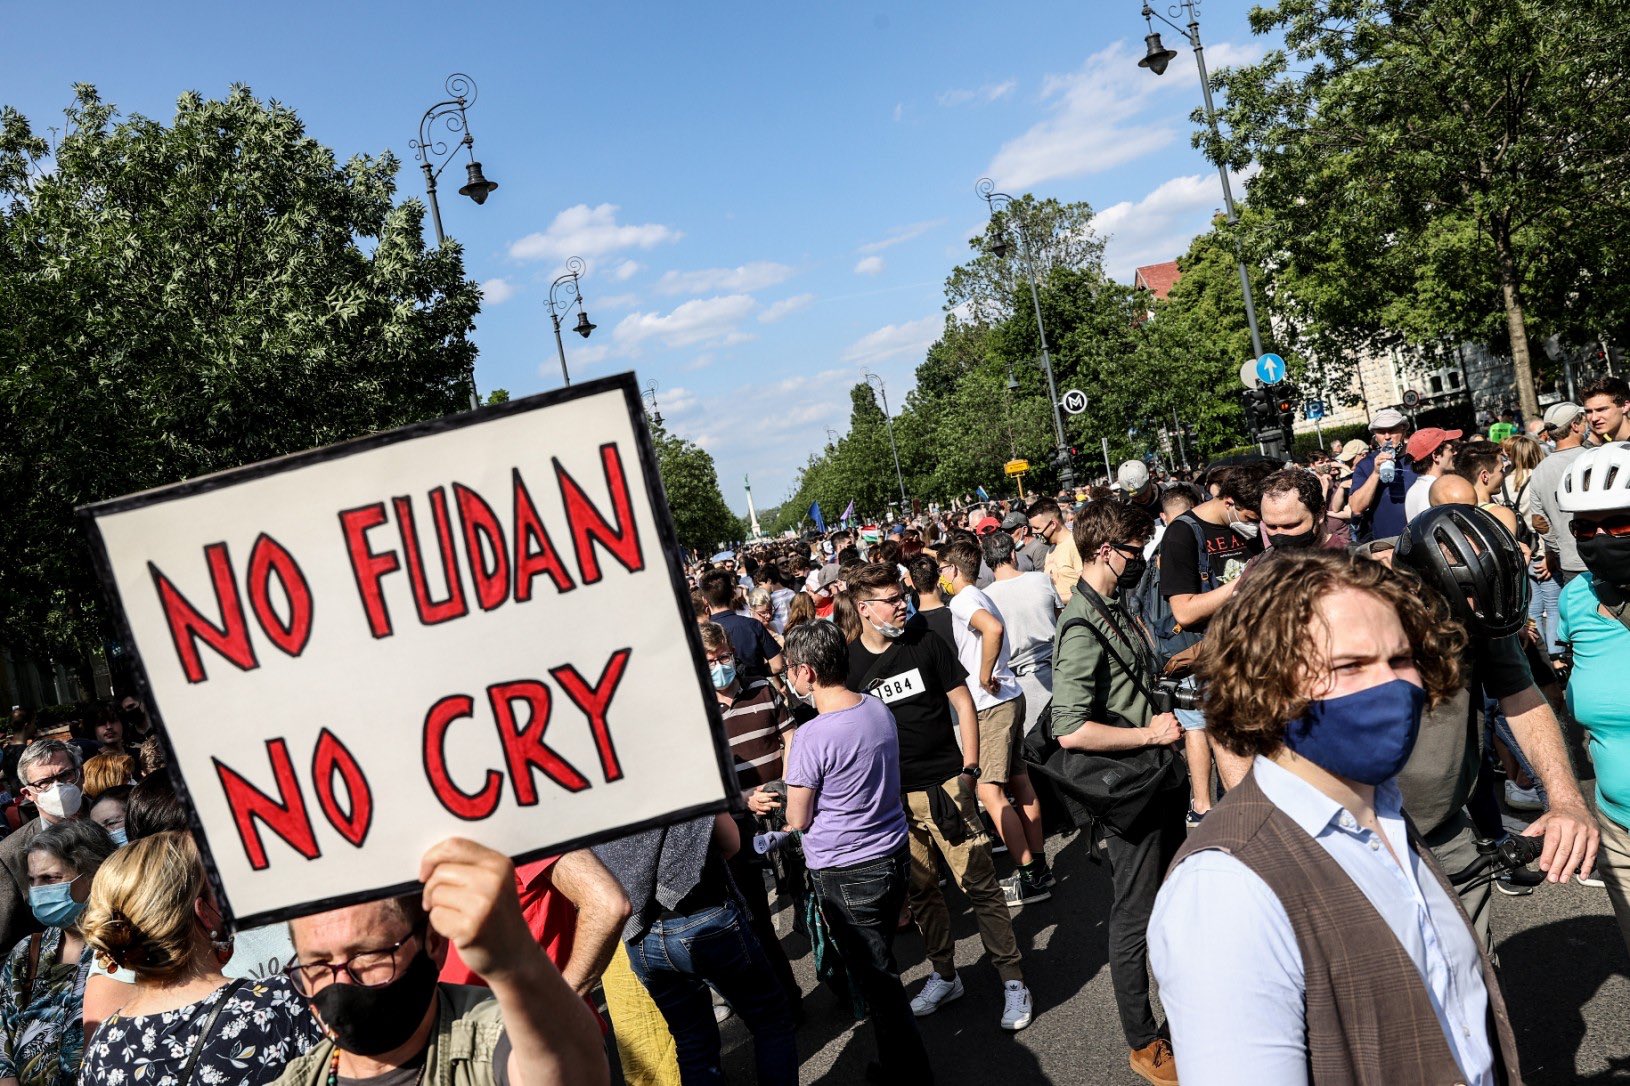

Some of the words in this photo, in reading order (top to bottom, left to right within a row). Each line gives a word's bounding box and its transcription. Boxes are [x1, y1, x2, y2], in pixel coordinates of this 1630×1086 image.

[147, 531, 313, 684] NO
[338, 441, 645, 639] FUDAN
[210, 727, 373, 871] NO
[421, 647, 632, 822] CRY
[876, 677, 912, 699] 1984
